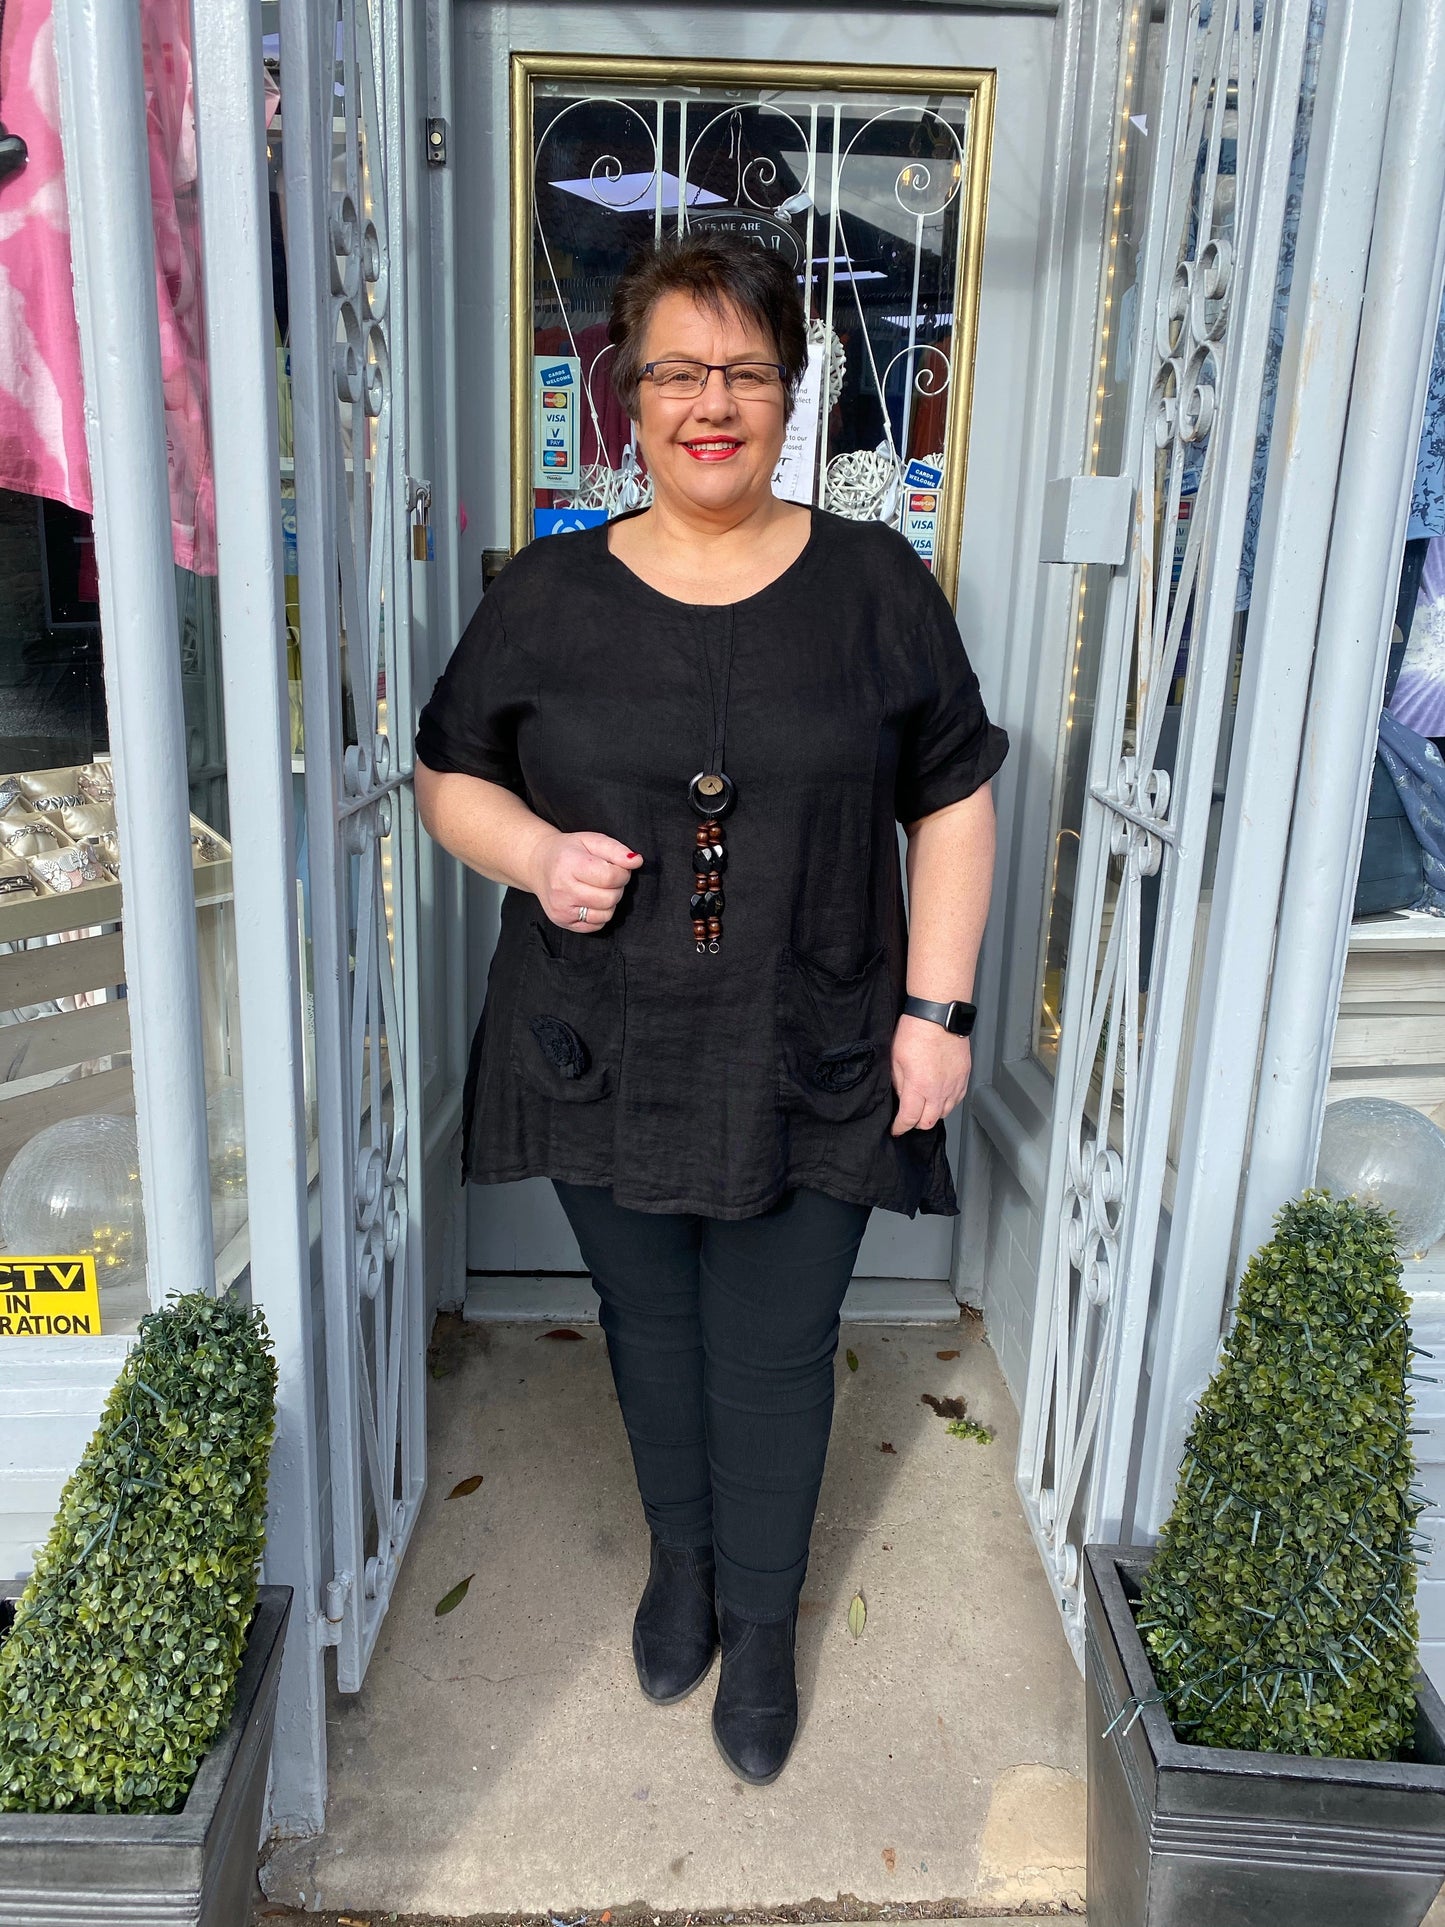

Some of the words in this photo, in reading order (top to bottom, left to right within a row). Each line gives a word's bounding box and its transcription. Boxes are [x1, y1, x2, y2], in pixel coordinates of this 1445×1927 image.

[721, 223, 736, 231] WE
[740, 222, 761, 231] ARE
[548, 370, 566, 378] CARDS
[545, 374, 571, 385] WELCOME
[546, 414, 566, 422] VISA
[551, 428, 560, 438] V
[790, 424, 800, 432] for
[915, 469, 934, 479] CARDS
[909, 474, 936, 488] WELCOME
[911, 520, 934, 529] VISA
[910, 539, 932, 549] VISA
[5, 1294, 31, 1314] IN
[0, 1315, 91, 1335] RATION
